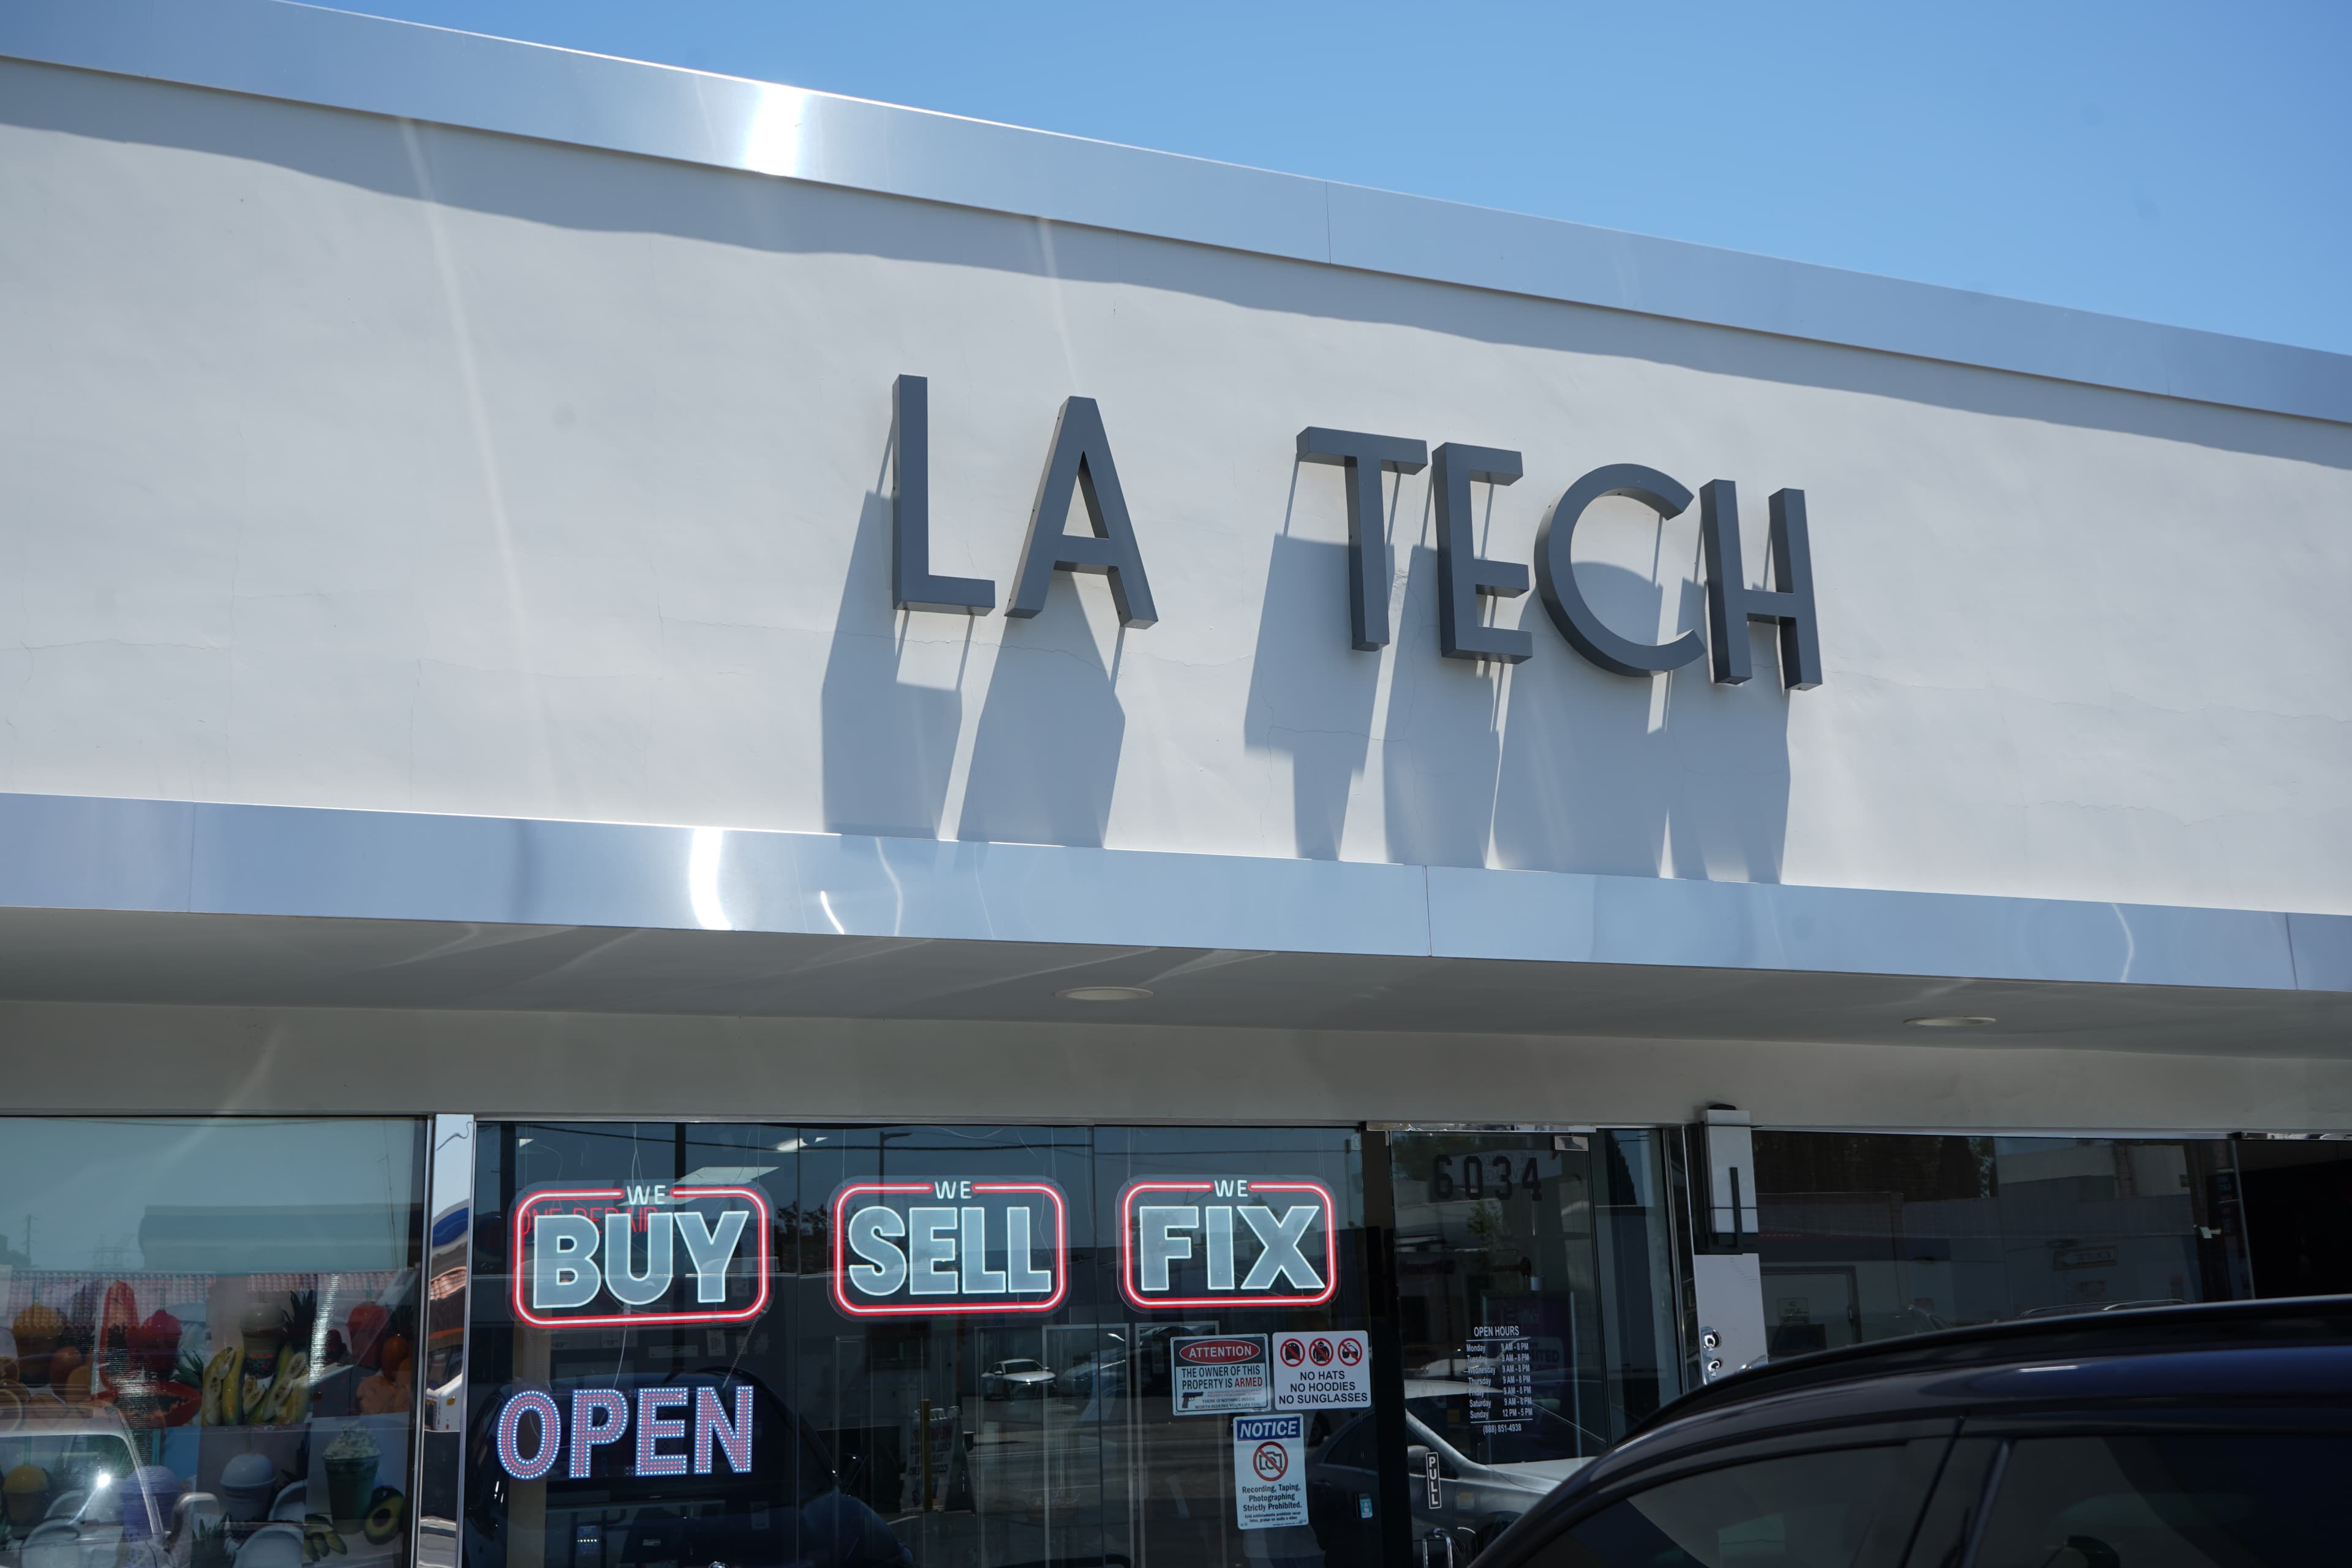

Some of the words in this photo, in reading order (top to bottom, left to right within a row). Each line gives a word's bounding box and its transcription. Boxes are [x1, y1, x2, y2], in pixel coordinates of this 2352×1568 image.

[892, 374, 1158, 628] LA
[1296, 426, 1822, 691] TECH
[1435, 1148, 1542, 1200] 6034
[935, 1181, 972, 1199] WE
[1214, 1180, 1248, 1197] WE
[626, 1185, 667, 1205] WE
[848, 1205, 1051, 1296] SELL
[1139, 1205, 1325, 1291] FIX
[533, 1211, 750, 1309] BUY
[1474, 1326, 1493, 1336] OPEN
[1495, 1325, 1519, 1336] HOURS
[1189, 1346, 1252, 1358] ATTENTION
[1466, 1344, 1485, 1353] Monday
[1466, 1355, 1487, 1365] Tuesday
[1182, 1368, 1197, 1378] THE
[1199, 1366, 1229, 1378] OWNER
[1231, 1366, 1240, 1376] OF
[1243, 1365, 1260, 1375] THIS
[1468, 1365, 1496, 1375] Wednesday
[1300, 1371, 1315, 1381] NO
[1318, 1371, 1345, 1380] HATS
[1468, 1377, 1491, 1386] Thursday
[1182, 1379, 1223, 1390] PROPERTY
[1226, 1379, 1232, 1388] IS
[1235, 1377, 1262, 1387] ARMED
[1290, 1383, 1305, 1392] NO
[1309, 1382, 1355, 1392] HOODIES
[1279, 1395, 1294, 1404] NO
[1297, 1393, 1368, 1404] SUNGLASSES
[1469, 1400, 1491, 1408] Saturday
[1470, 1411, 1489, 1420] Sunday
[497, 1385, 753, 1480] OPEN
[1240, 1421, 1297, 1438] NOTICE
[1483, 1425, 1496, 1435] (888)
[1498, 1424, 1521, 1433] 851-4938
[1428, 1456, 1439, 1505] PULL
[1279, 1483, 1300, 1492] Taping,
[1249, 1493, 1295, 1502] Photographing
[1243, 1503, 1266, 1512] Strictly
[1268, 1501, 1302, 1510] Prohibited.
